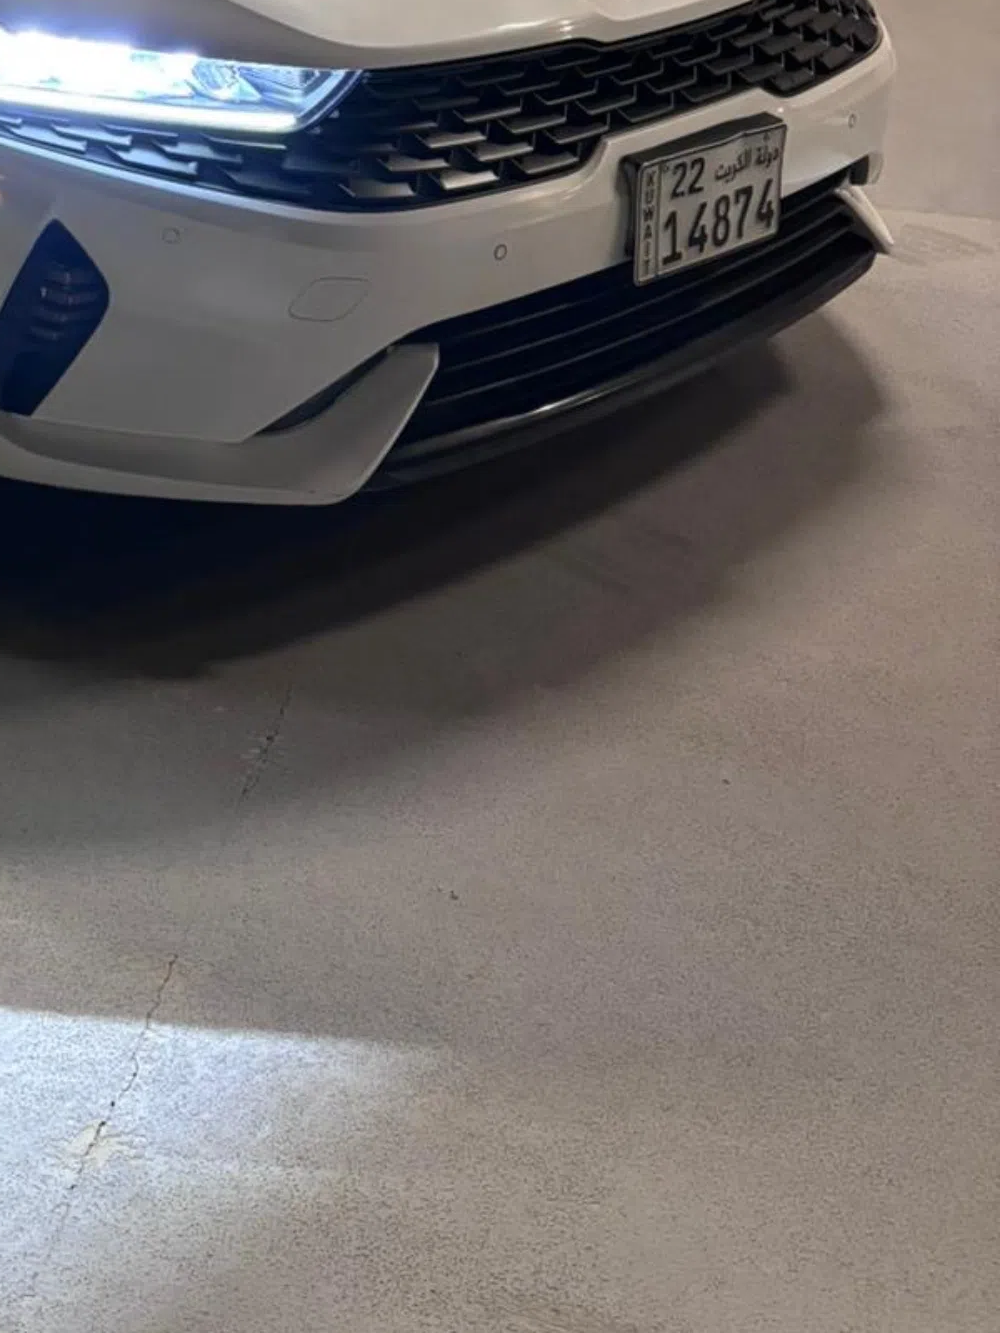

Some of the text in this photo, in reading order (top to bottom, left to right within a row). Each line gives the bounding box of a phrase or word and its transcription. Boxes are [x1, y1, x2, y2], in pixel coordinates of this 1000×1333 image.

[671, 157, 706, 200] 22
[714, 148, 753, 184] الكويت
[643, 169, 657, 277] KUWAIT
[661, 177, 775, 266] 14874
